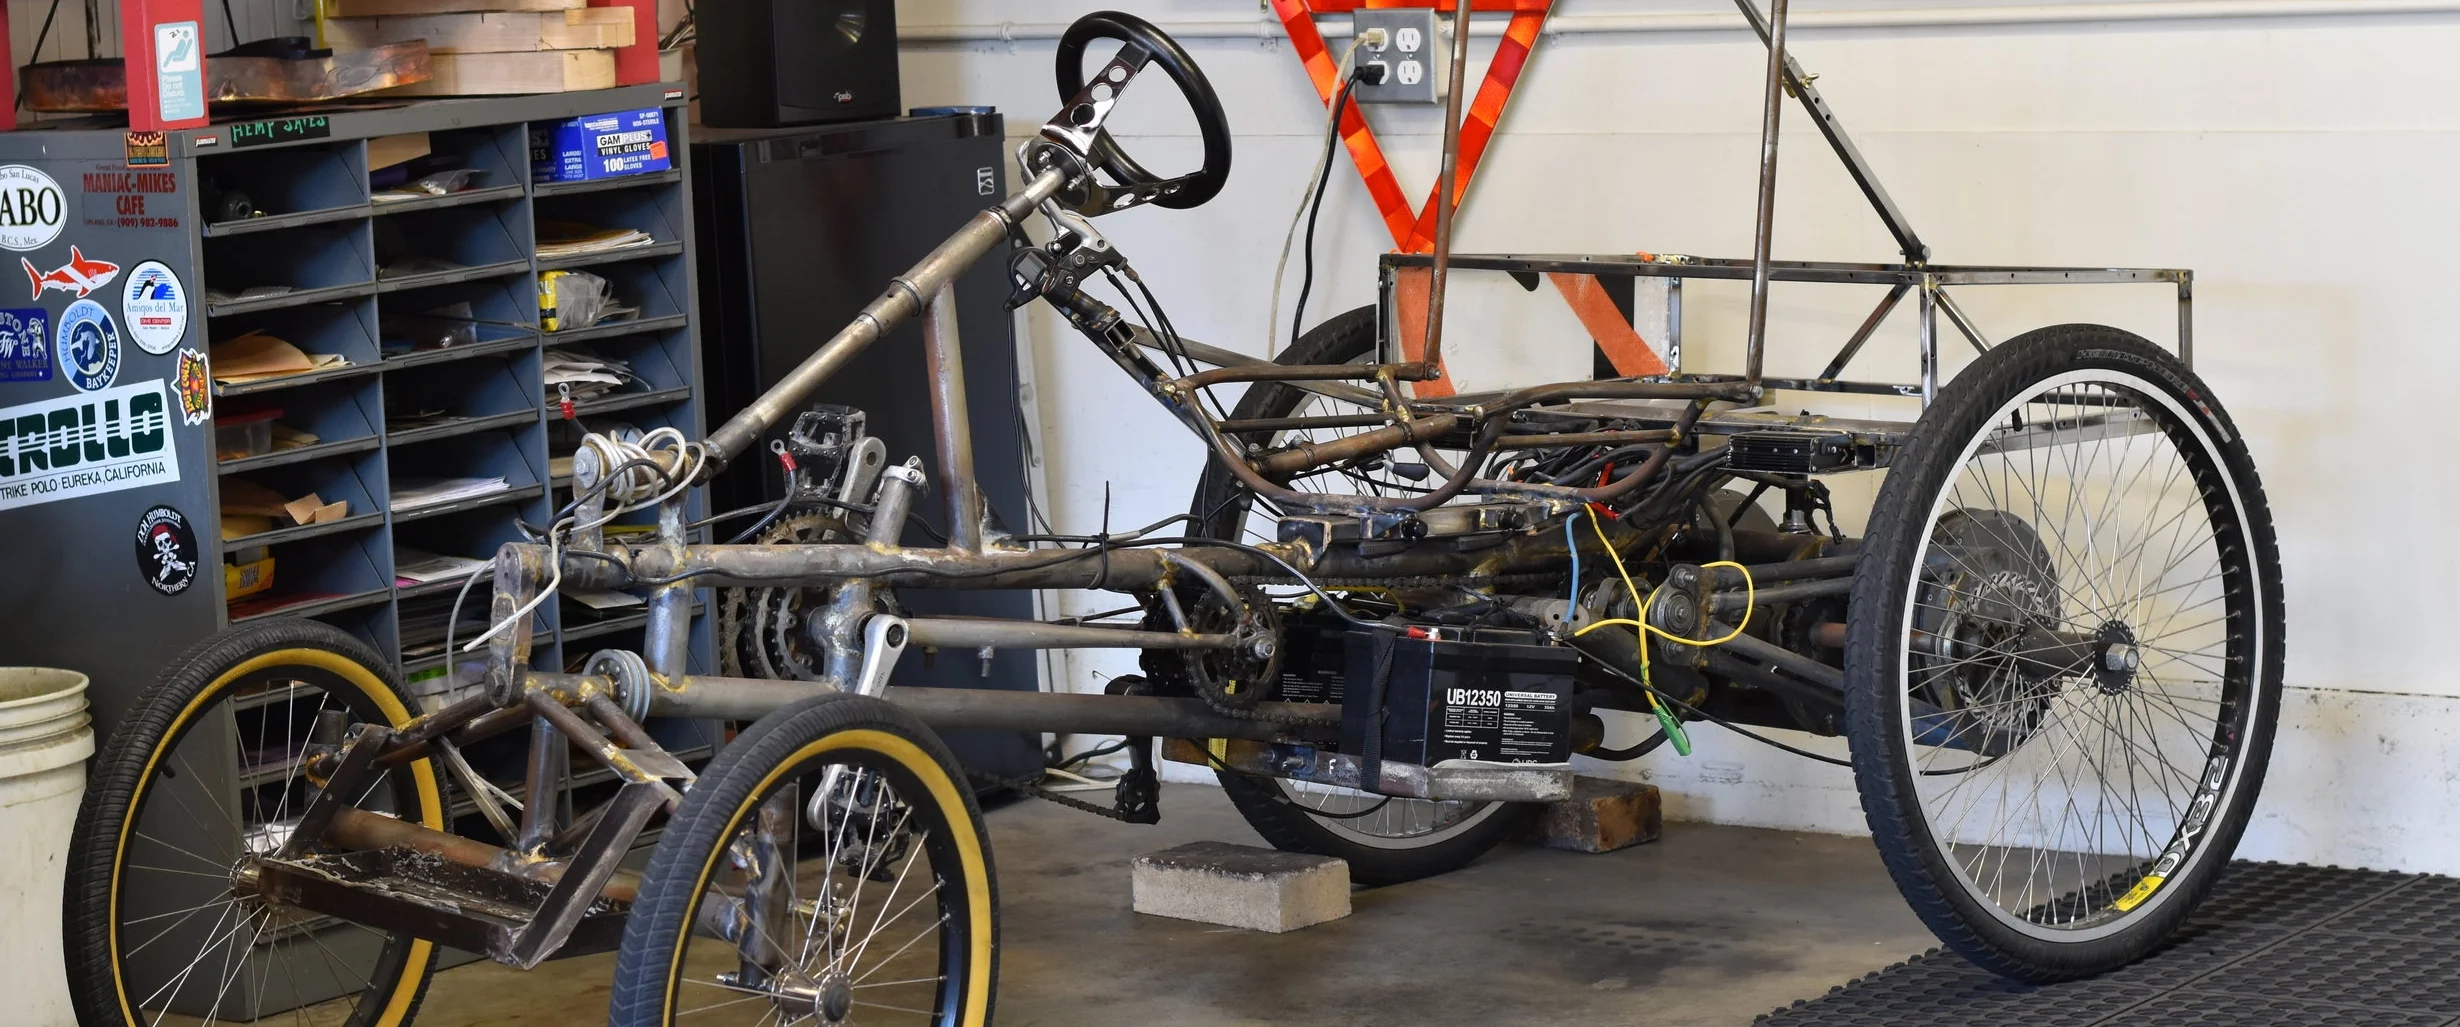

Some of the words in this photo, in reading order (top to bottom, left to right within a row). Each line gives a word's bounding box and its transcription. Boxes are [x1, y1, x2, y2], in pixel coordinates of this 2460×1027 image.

[162, 75, 182, 83] Please
[601, 147, 622, 156] VINYL
[624, 143, 650, 152] GLOVES
[604, 158, 623, 172] 100
[9, 169, 20, 178] San
[22, 170, 39, 183] Lucas
[83, 173, 176, 193] MANIAC-MIKES
[116, 195, 144, 215] CAFE
[117, 217, 138, 228] (909)
[140, 217, 178, 228] 982-9886
[127, 301, 152, 316] Amigos
[155, 302, 165, 312] del
[169, 302, 184, 312] Mar
[61, 306, 94, 362] HUMBOLDT
[86, 331, 116, 389] BAYKEEPER
[181, 356, 192, 387] COAST
[183, 389, 195, 414] LOST
[0, 483, 28, 500] TRIKE
[31, 478, 57, 494] POLO
[61, 471, 106, 489] EUREKA,
[104, 461, 165, 482] CALIFORNIA
[147, 508, 181, 524] HUMBOLDT
[152, 576, 189, 594] NORTHERN
[1446, 688, 1501, 707] UB12350
